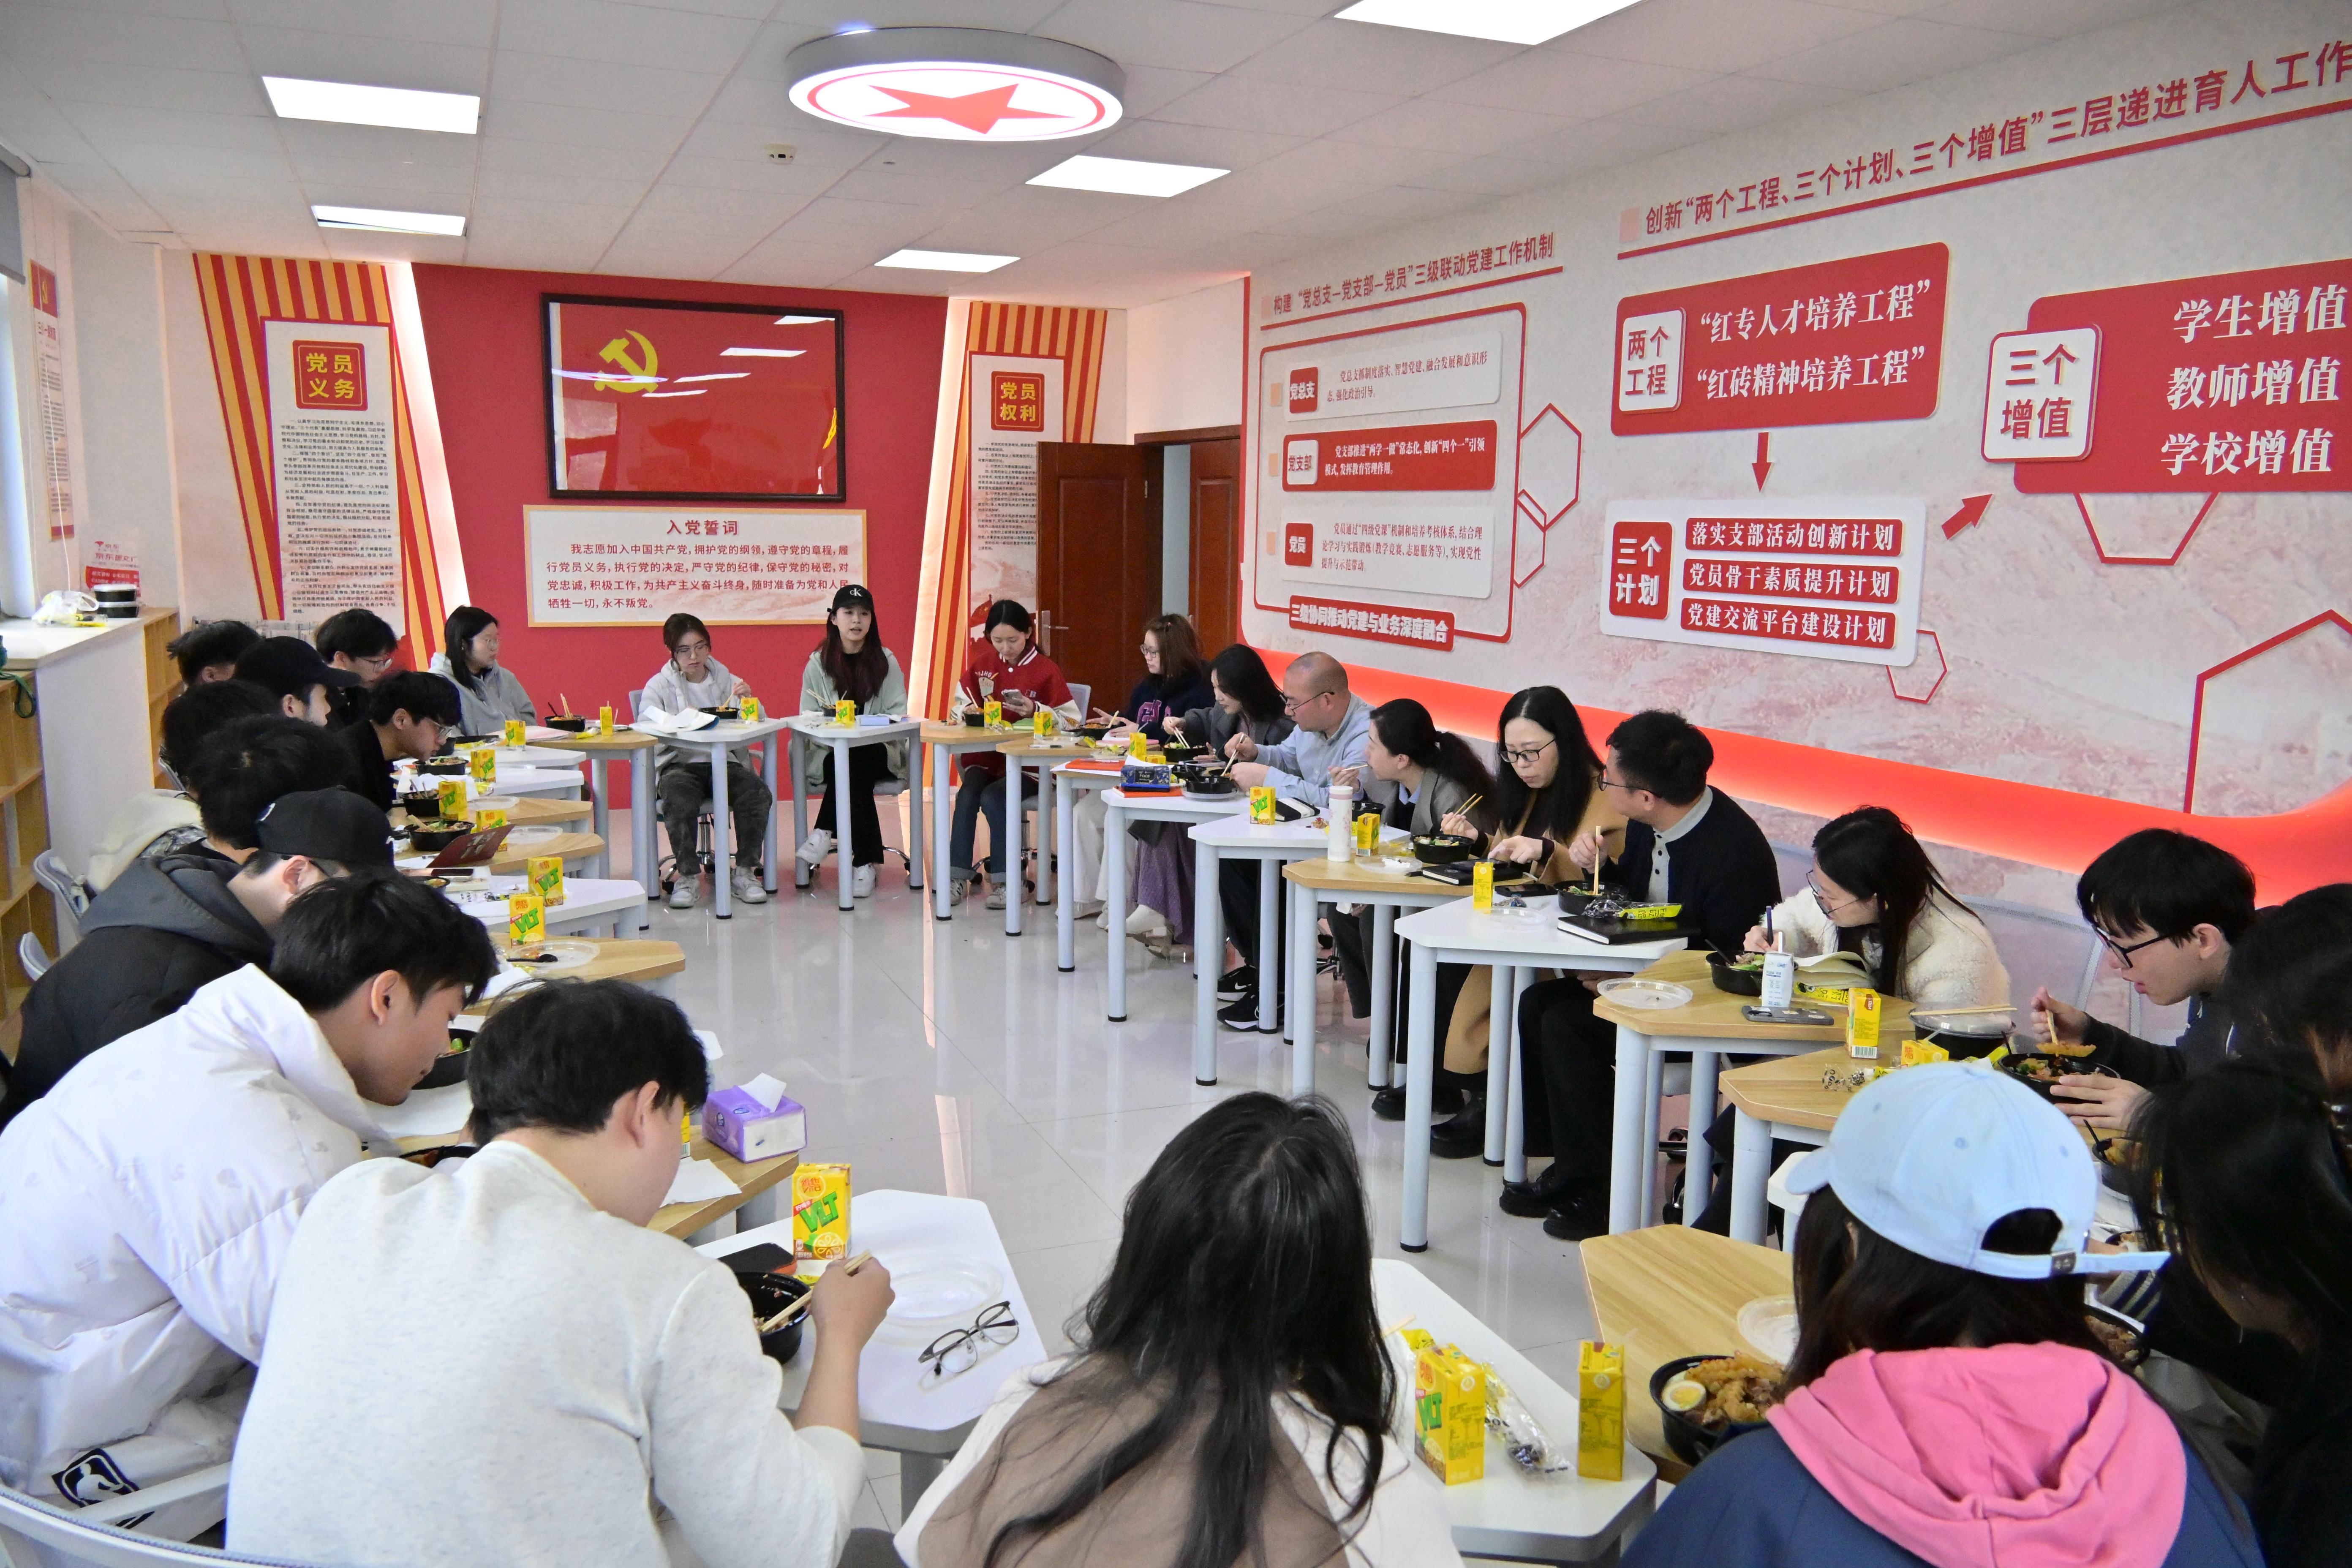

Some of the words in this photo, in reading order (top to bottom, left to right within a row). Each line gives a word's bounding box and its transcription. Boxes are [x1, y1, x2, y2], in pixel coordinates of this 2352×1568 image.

[1701, 279, 1930, 343] “红专人才培养工程”
[2174, 284, 2349, 344] 学生增值
[1627, 326, 1669, 361] 两个
[306, 353, 353, 374] 党员
[1697, 346, 1925, 400] “红砖精神培养工程”
[2005, 343, 2080, 386] 三个
[308, 378, 354, 399] 义务
[1001, 382, 1036, 400] 党员
[1290, 382, 1316, 400] 党总支
[1625, 364, 1666, 396] 工程
[2166, 357, 2341, 411] 教师增值
[1000, 403, 1036, 422] 权利
[2000, 397, 2073, 440] 增值
[1288, 455, 1312, 472] 党支部
[2161, 428, 2334, 476] 学校增值
[667, 520, 739, 536] 入党誓词
[1691, 522, 1894, 550] 落实支部活动创新计划
[571, 543, 849, 556] 我志愿加入中国共产党，拥护党的纲领，遵守党的章程，履
[1289, 536, 1306, 553] 党员
[1617, 536, 1662, 567] 三个
[547, 561, 849, 574] 行党员义务，执行党的决定，严守党的纪律，保守党的秘密，对
[1689, 563, 1890, 598] 党员骨干素质提升计划
[548, 598, 655, 609] 牺牲一切，永不叛党。
[1616, 573, 1659, 606] 计划
[1290, 603, 1448, 643] 三级协同推动党建与业务深度融合
[1688, 603, 1886, 643] 党建交流平台建设计划
[538, 867, 559, 892] VLT
[514, 908, 539, 934] VLT
[800, 1192, 838, 1233] VLT
[1417, 1392, 1442, 1431] VLT
